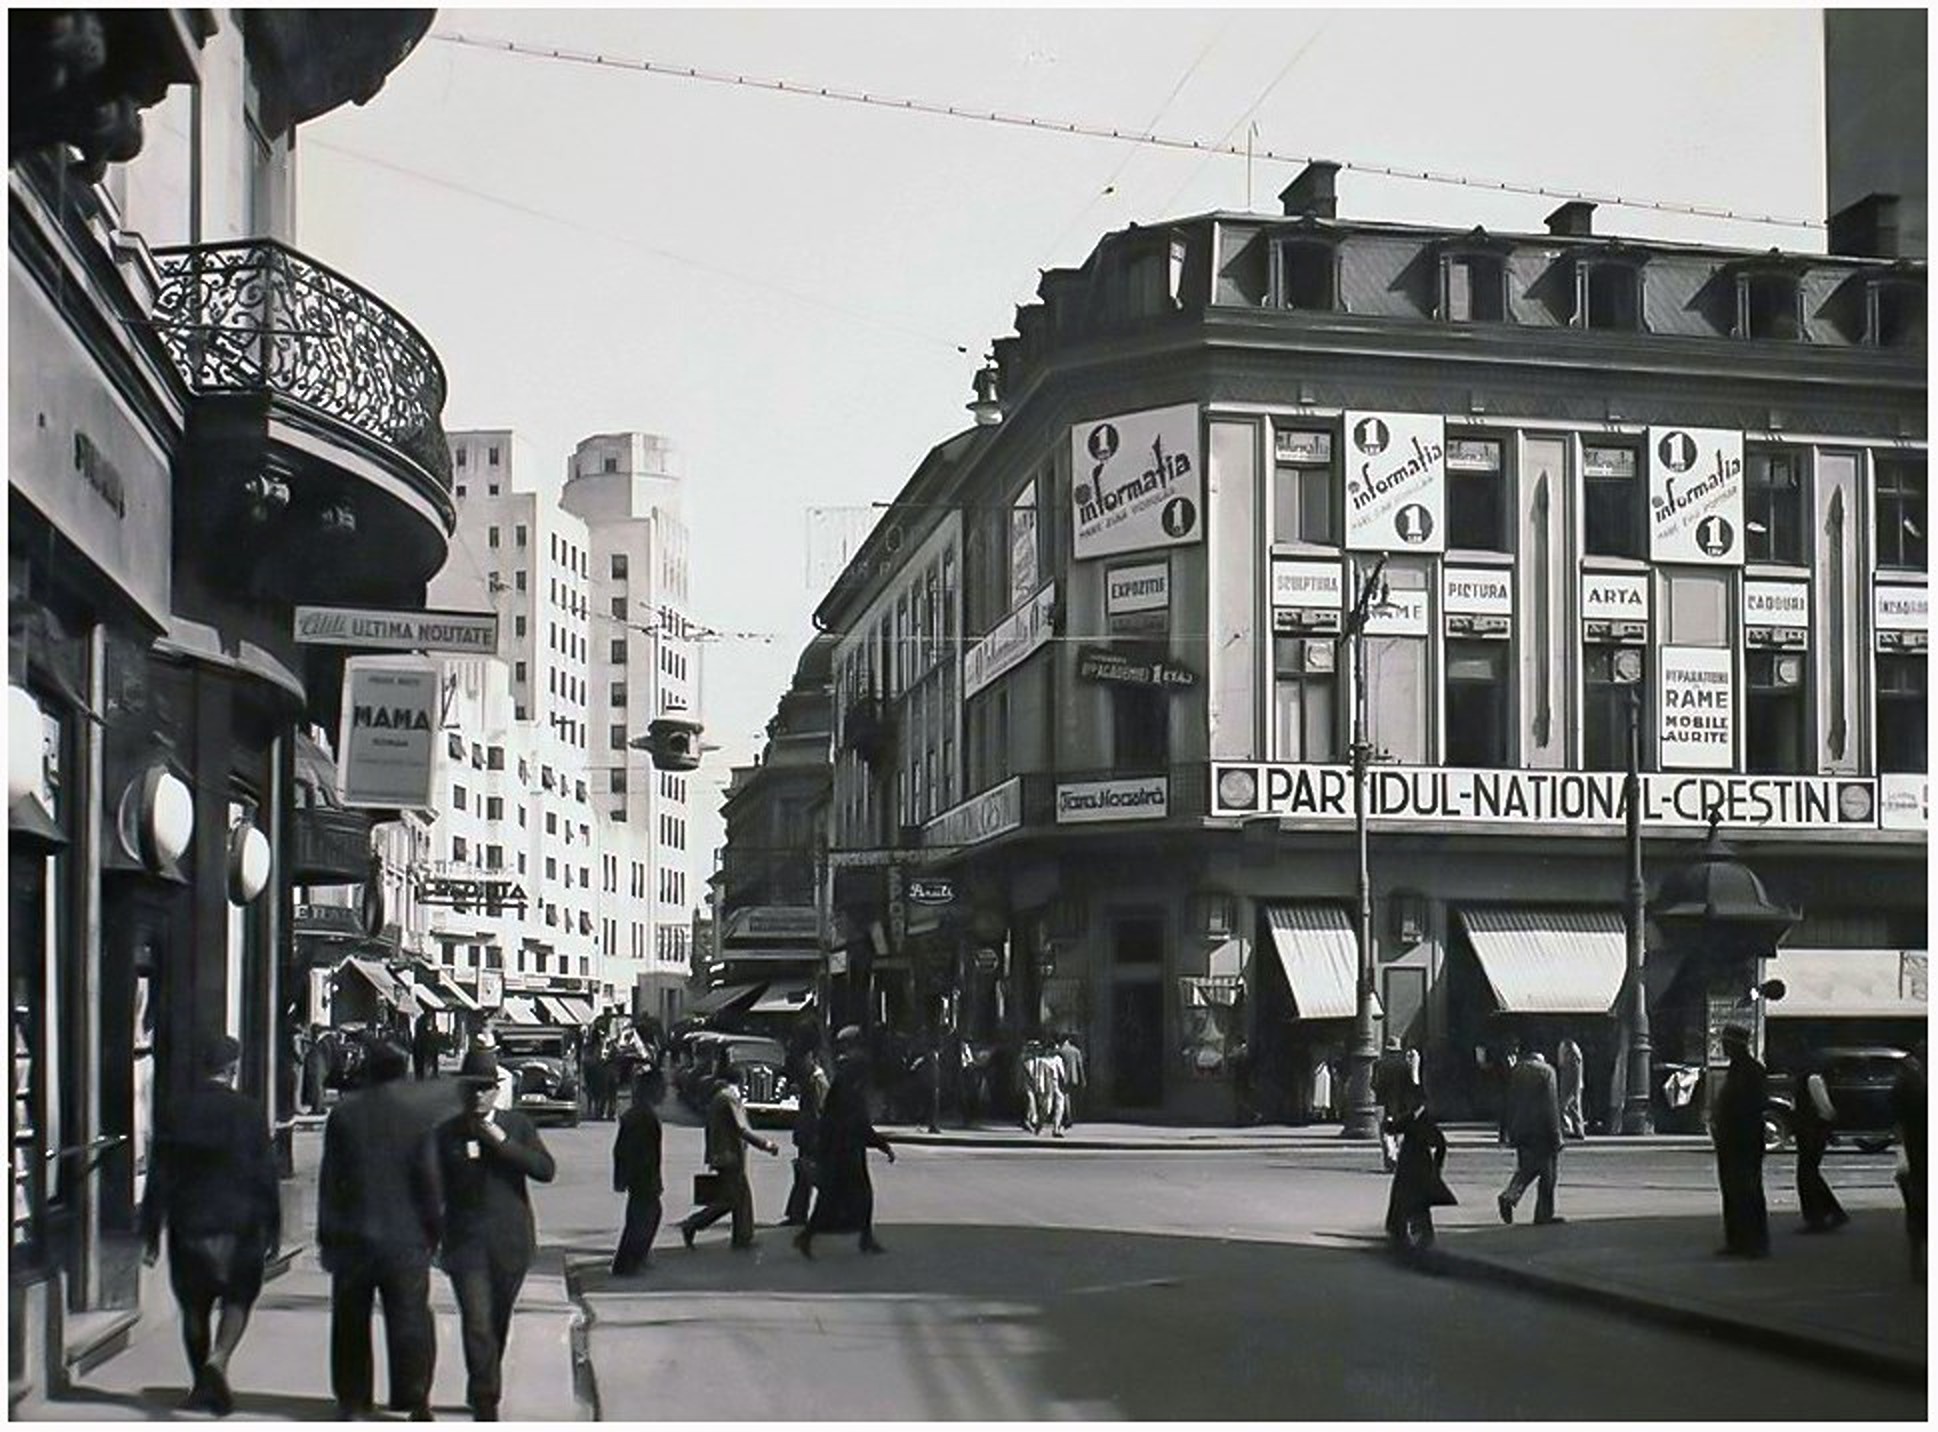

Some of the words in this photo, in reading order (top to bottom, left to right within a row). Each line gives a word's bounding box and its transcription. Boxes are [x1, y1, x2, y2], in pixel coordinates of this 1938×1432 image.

[1448, 582, 1508, 599] PICTURA
[1589, 588, 1642, 604] ARTA
[352, 619, 414, 640] ULTIMA
[418, 624, 493, 644] NOUTATE
[1666, 690, 1728, 708] RAME
[354, 705, 430, 730] MAMA
[1666, 716, 1728, 729] MOBILE
